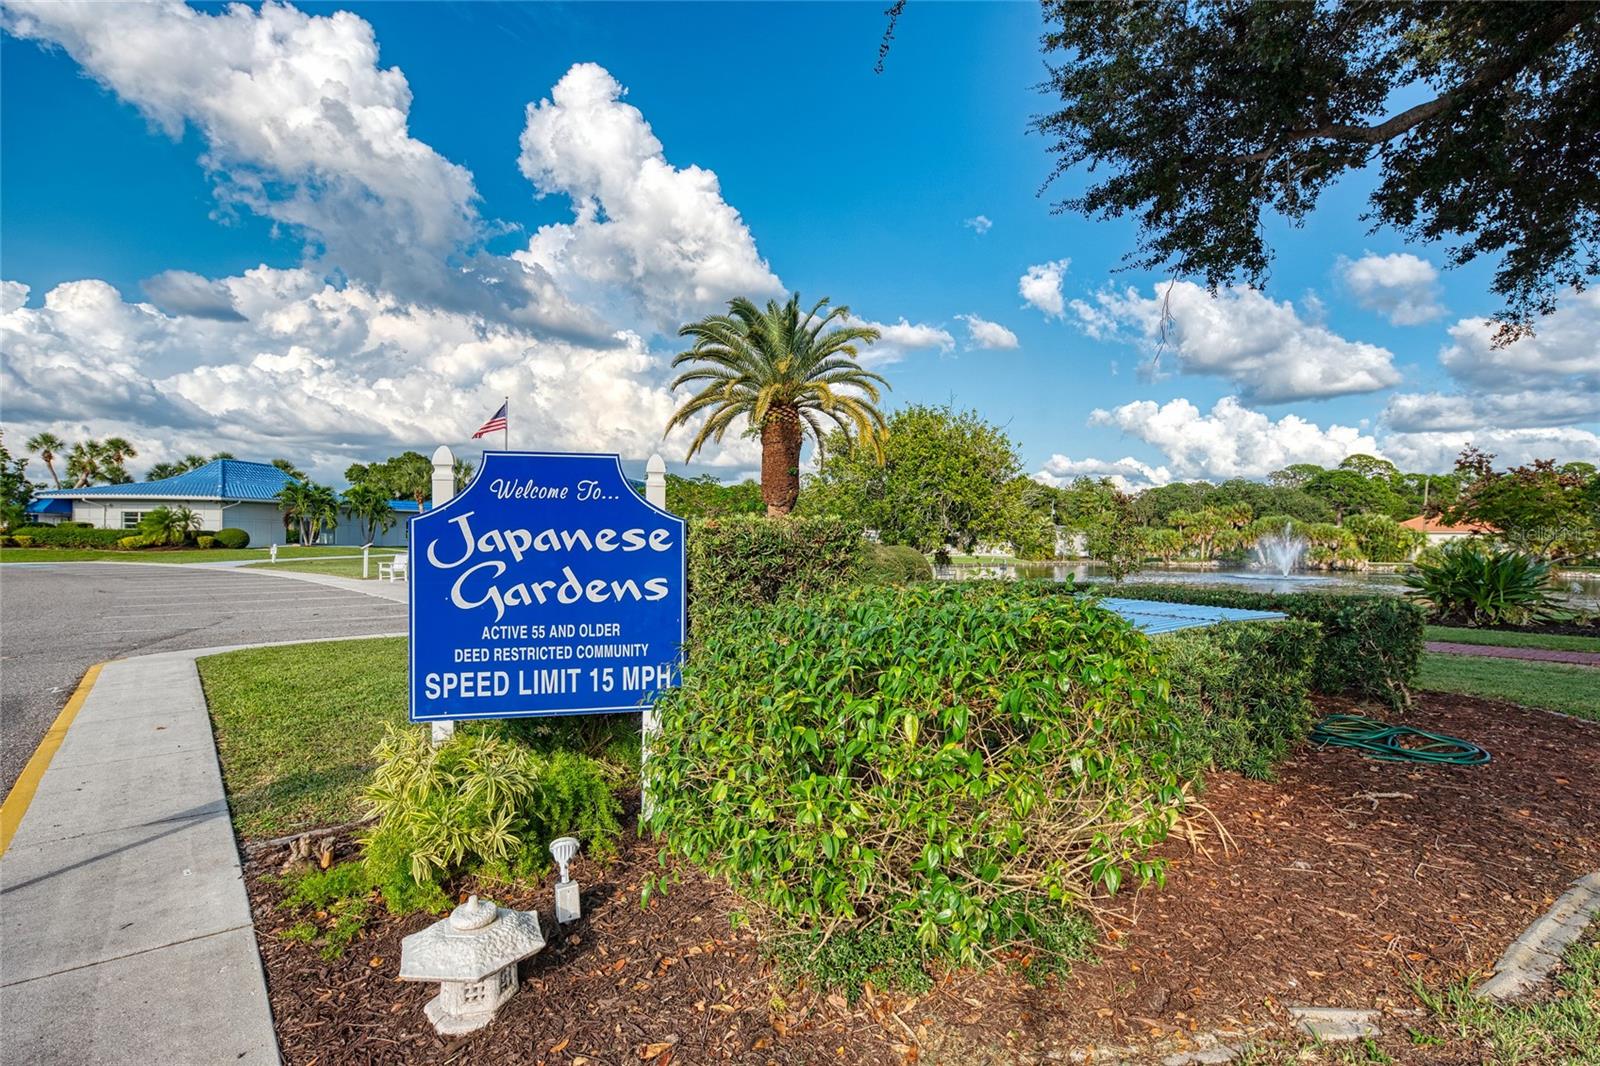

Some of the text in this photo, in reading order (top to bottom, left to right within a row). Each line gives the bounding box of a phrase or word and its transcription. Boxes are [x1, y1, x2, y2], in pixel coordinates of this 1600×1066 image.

[489, 478, 619, 501] Welcome To...
[427, 511, 673, 569] Japanese
[451, 560, 669, 623] Gardens
[481, 623, 621, 640] ACTIVE 55 AND OLDER
[454, 643, 649, 663] DEED RESTRICTED COMMUNITY
[424, 664, 672, 700] SPEED LIMIT 15 MPH
